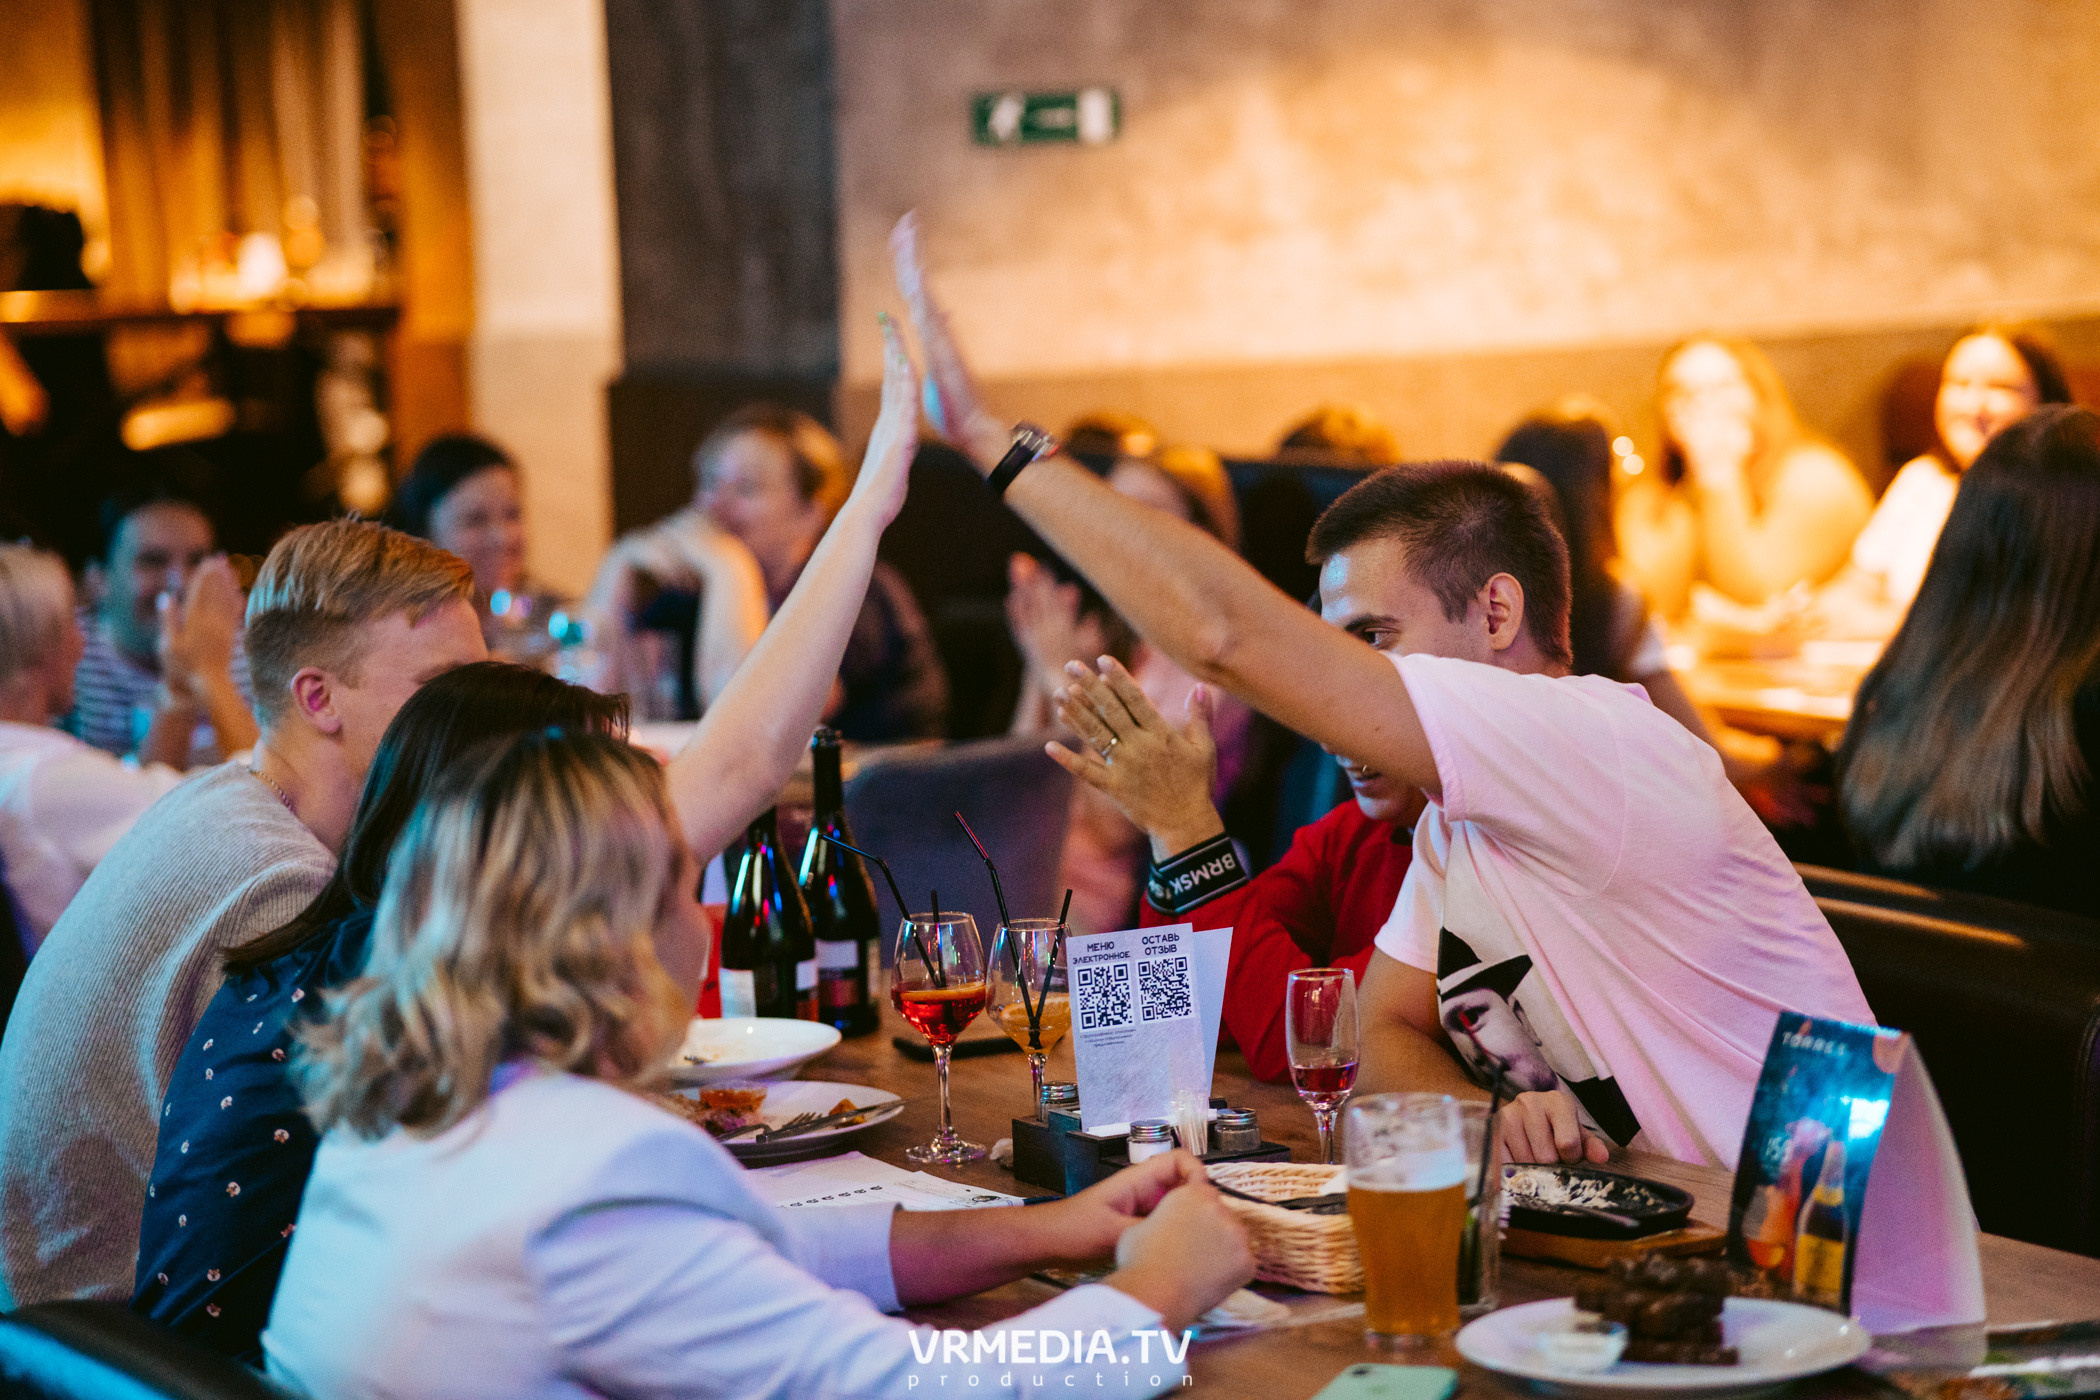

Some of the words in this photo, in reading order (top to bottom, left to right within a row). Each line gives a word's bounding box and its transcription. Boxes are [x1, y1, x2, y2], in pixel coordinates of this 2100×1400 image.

[1169, 853, 1236, 896] BRMSK
[1141, 933, 1180, 946] ОСТАВЬ
[1086, 941, 1115, 953] МЕНЮ
[1144, 944, 1178, 956] ОТЗЫВ
[1072, 950, 1131, 965] ЭЛЕКТРОННОЕ
